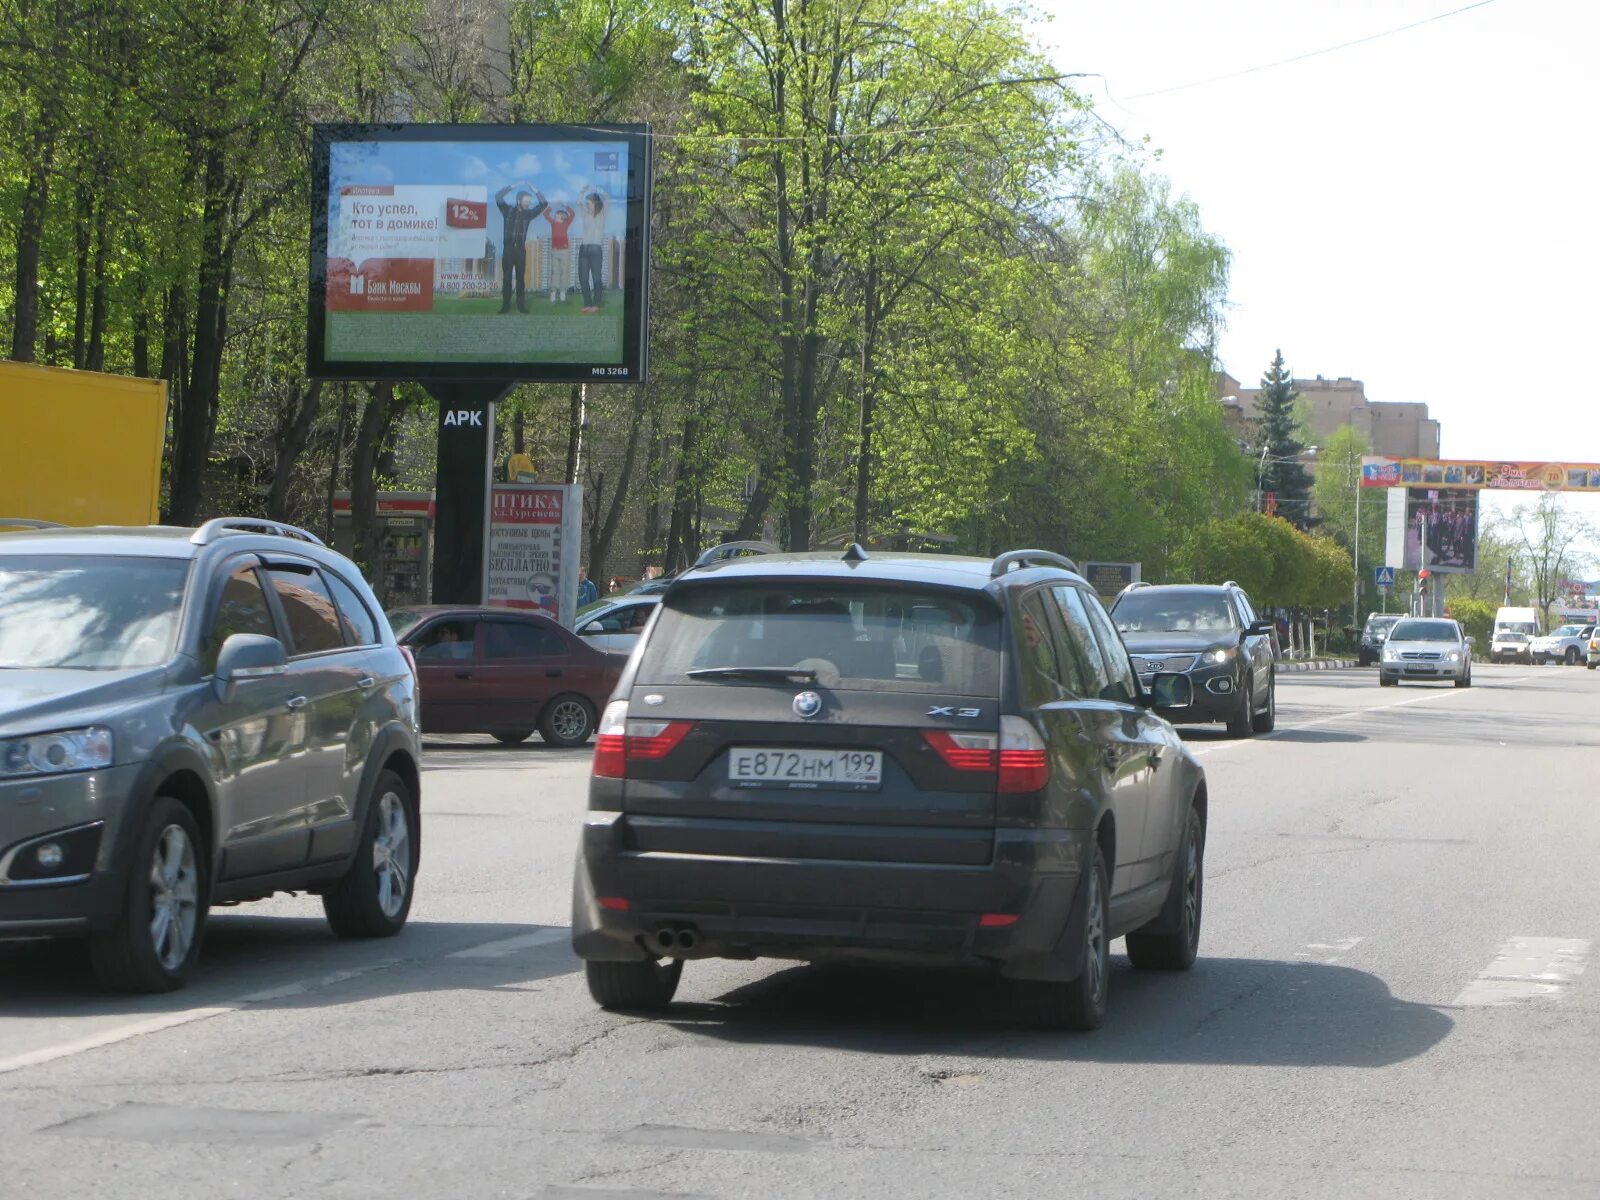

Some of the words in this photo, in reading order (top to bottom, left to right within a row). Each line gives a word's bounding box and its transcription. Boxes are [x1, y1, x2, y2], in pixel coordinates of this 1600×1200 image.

[353, 201, 374, 215] Кто
[378, 204, 418, 218] успел,
[452, 205, 479, 221] 12%
[352, 219, 373, 230] тот
[376, 219, 384, 230] в
[387, 218, 438, 233] домике!
[367, 279, 387, 295] Банк
[389, 279, 421, 295] Москвы
[494, 494, 560, 509] ПТИКА
[926, 704, 982, 718] X3
[840, 752, 875, 773] 199
